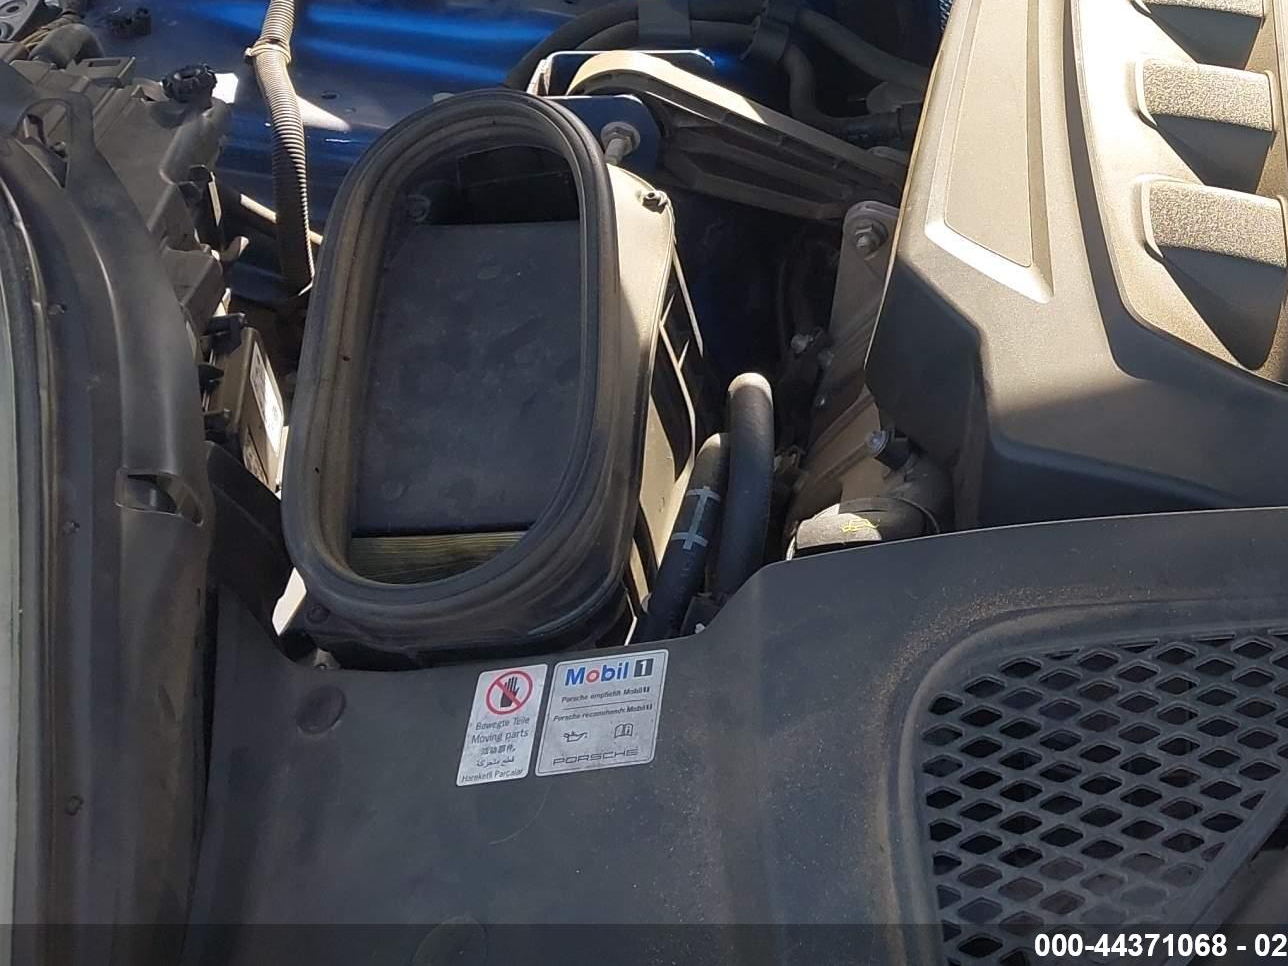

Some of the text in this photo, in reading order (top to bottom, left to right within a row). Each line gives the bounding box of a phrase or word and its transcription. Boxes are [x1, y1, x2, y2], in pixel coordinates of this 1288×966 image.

[564, 661, 630, 686] Mobil
[475, 716, 530, 731] Bewegte Teile
[471, 729, 529, 744] Moving parts
[552, 748, 640, 767] PORSCHE
